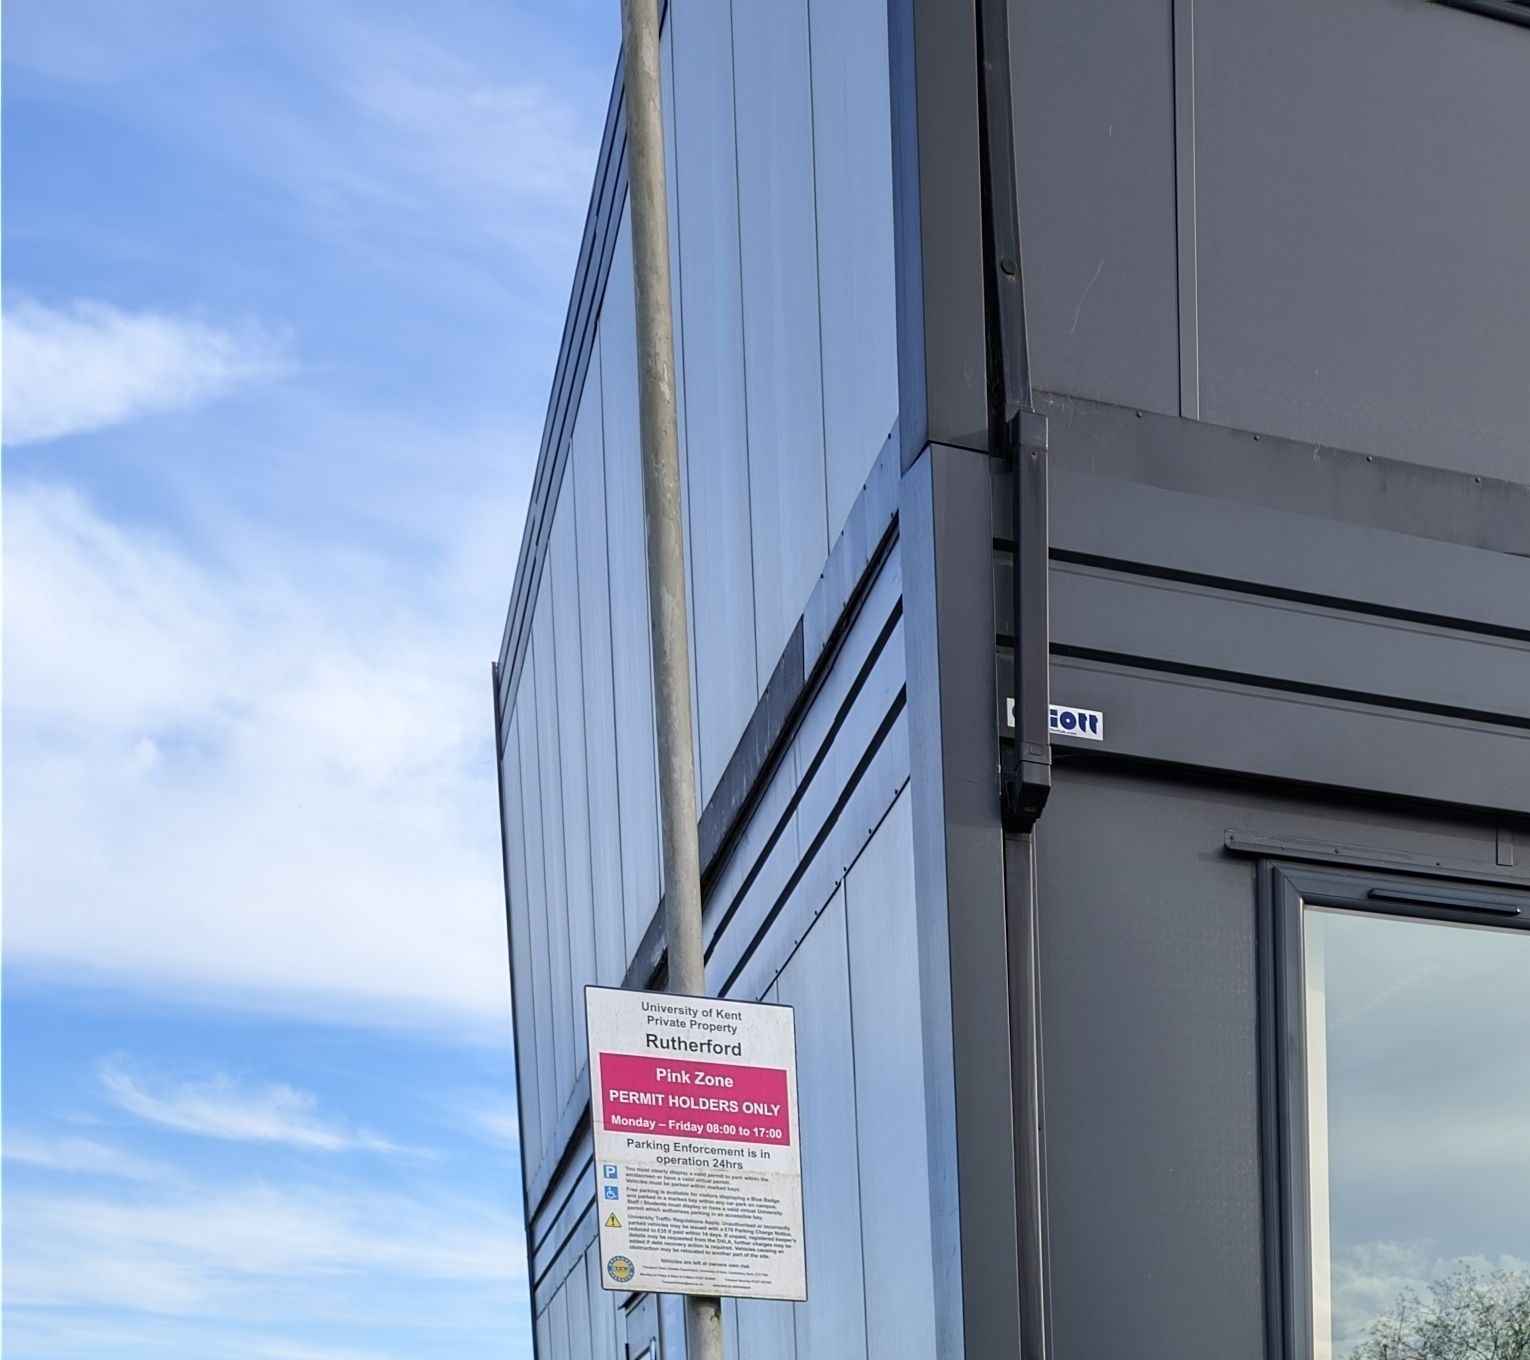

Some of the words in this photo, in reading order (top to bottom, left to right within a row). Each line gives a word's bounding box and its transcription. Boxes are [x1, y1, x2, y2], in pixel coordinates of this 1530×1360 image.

[641, 1002, 699, 1018] University
[702, 1008, 713, 1017] of
[716, 1009, 742, 1020] Kent
[647, 1016, 687, 1028] Private
[689, 1020, 738, 1035] Property
[646, 1034, 742, 1056] Rutherford
[656, 1069, 691, 1084] Pink
[694, 1072, 734, 1087] Zone
[609, 1091, 665, 1106] PERMIT
[668, 1096, 738, 1112] HOLDERS
[741, 1102, 780, 1116] ONLY
[611, 1116, 656, 1131] Monday
[668, 1120, 704, 1134] Friday
[706, 1123, 736, 1135] 08:00
[738, 1126, 750, 1136] to
[752, 1127, 782, 1138] 17:00
[627, 1139, 670, 1153] Parking
[672, 1143, 744, 1157] Enforcement
[747, 1149, 757, 1158] is
[759, 1150, 770, 1159] in
[656, 1155, 709, 1169] operation
[711, 1159, 743, 1169] 24hrs
